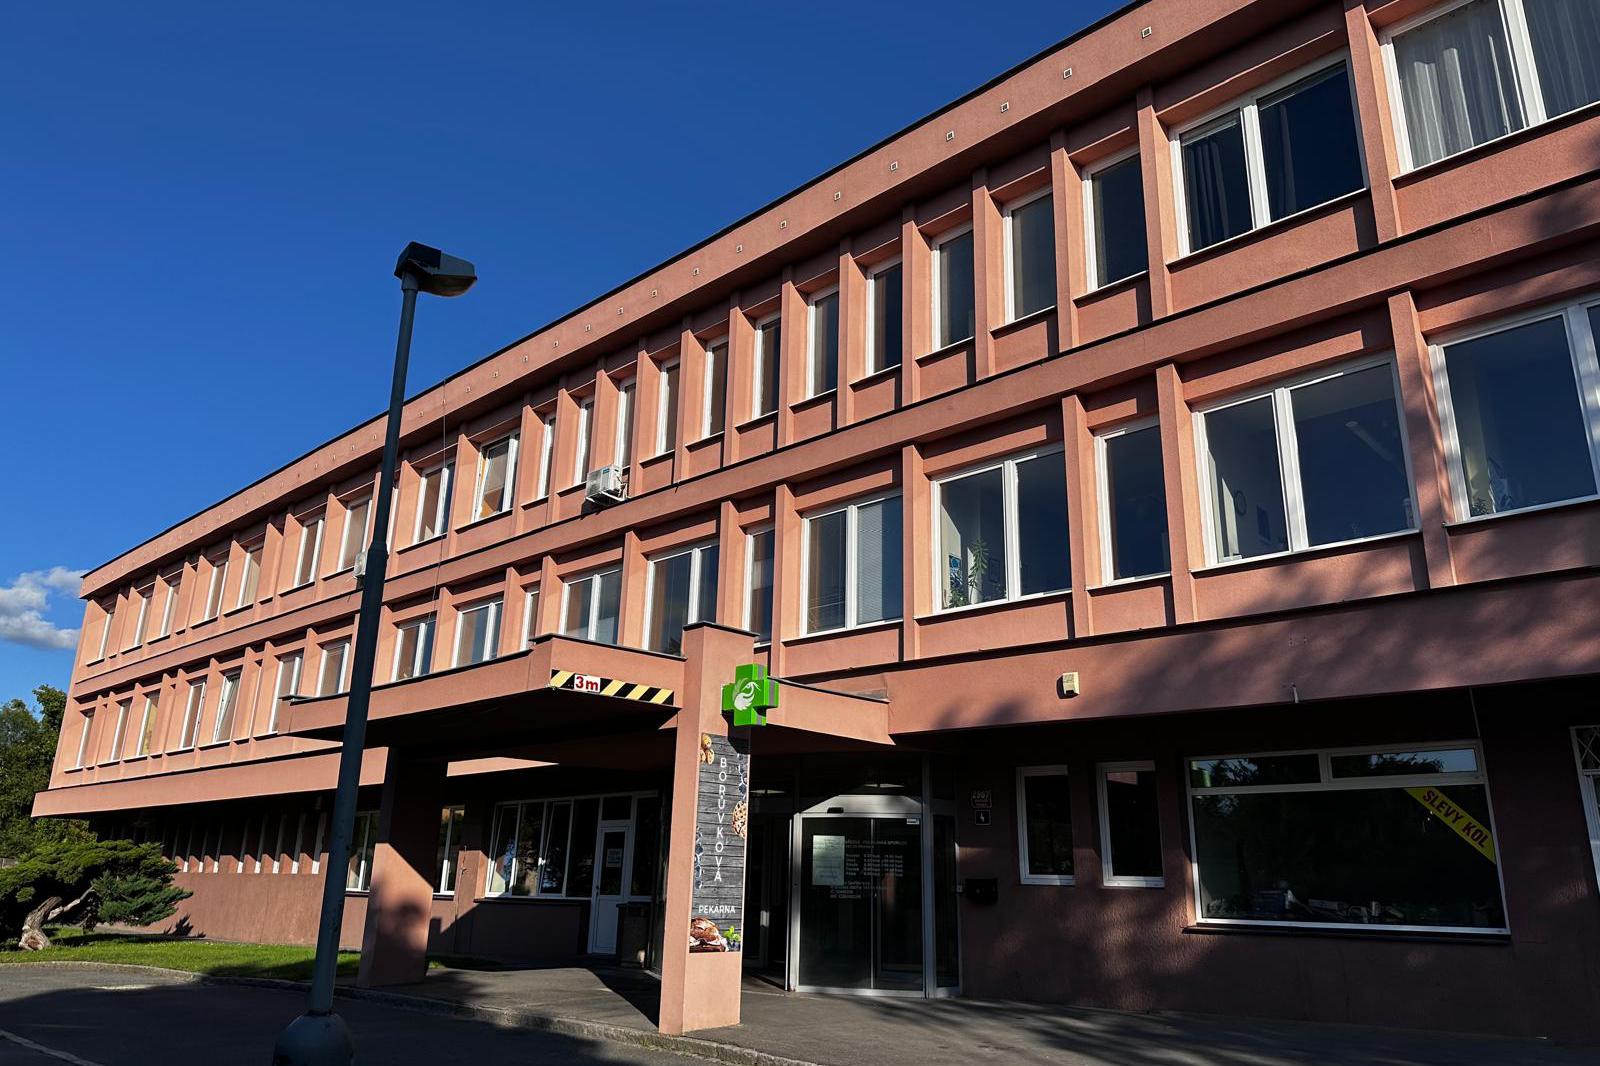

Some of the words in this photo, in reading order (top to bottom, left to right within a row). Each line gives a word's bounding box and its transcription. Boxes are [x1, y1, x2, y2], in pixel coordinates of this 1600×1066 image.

[713, 757, 728, 882] BORŮVKOVÁ
[1422, 790, 1464, 824] SLEVY
[1462, 821, 1489, 848] KOL
